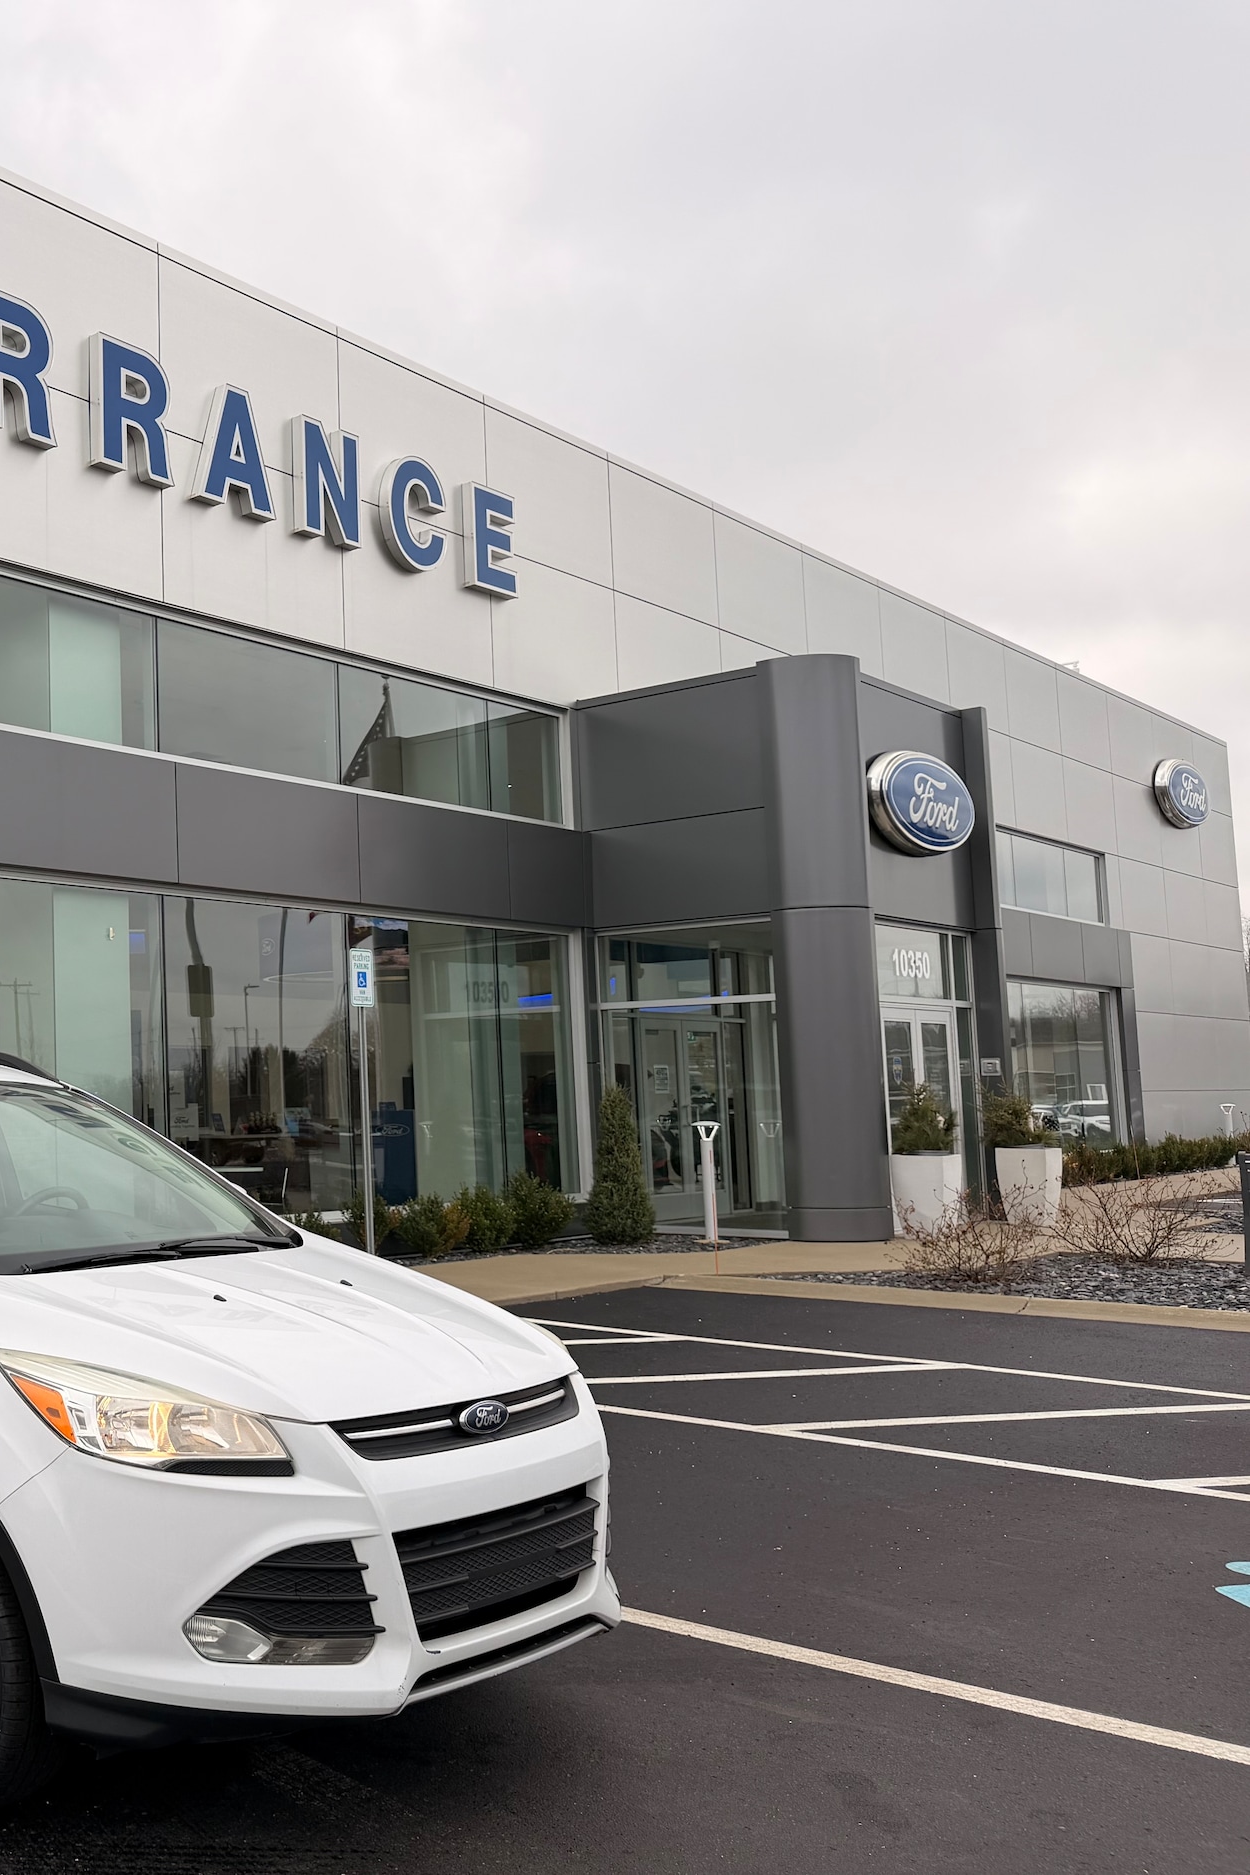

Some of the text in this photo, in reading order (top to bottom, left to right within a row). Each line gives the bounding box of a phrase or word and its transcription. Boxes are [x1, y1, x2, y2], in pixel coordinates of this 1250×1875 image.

[909, 772, 959, 832] Ford
[1180, 773, 1207, 812] Ford
[892, 948, 931, 979] 10350
[381, 1125, 404, 1135] Ford
[475, 1406, 502, 1428] Ford
